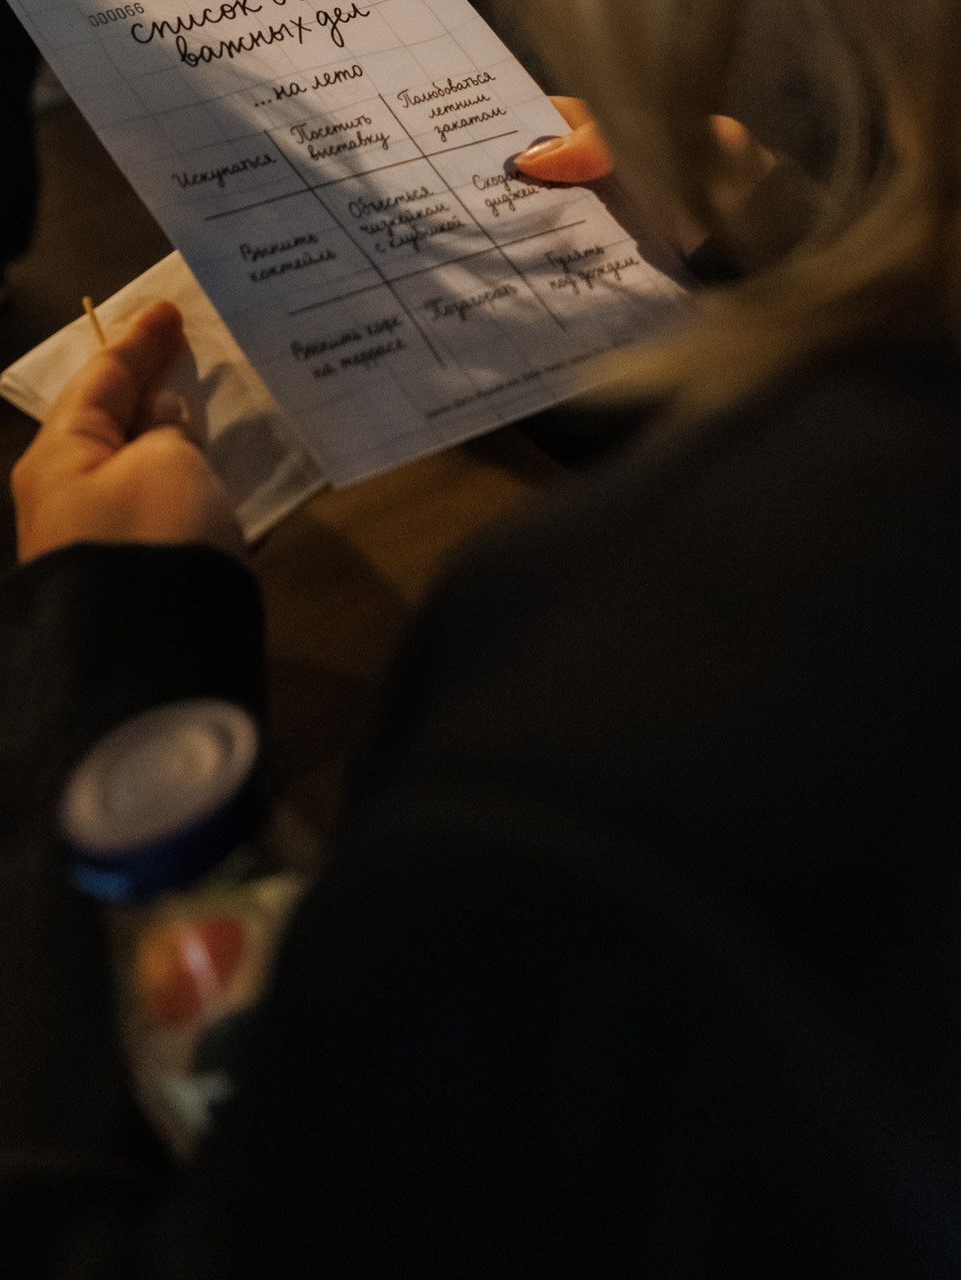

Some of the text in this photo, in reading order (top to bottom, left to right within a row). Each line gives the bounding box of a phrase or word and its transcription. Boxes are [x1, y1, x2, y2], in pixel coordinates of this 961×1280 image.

[88, 2, 145, 27] 000066
[176, 3, 371, 67] важных дел
[312, 64, 363, 89] лето
[397, 71, 496, 108] Полюбоваться
[429, 93, 491, 119] летним
[289, 115, 372, 145] Посетить
[433, 107, 507, 143] закатом
[308, 131, 390, 161] выставку
[171, 153, 277, 188] Искупаться
